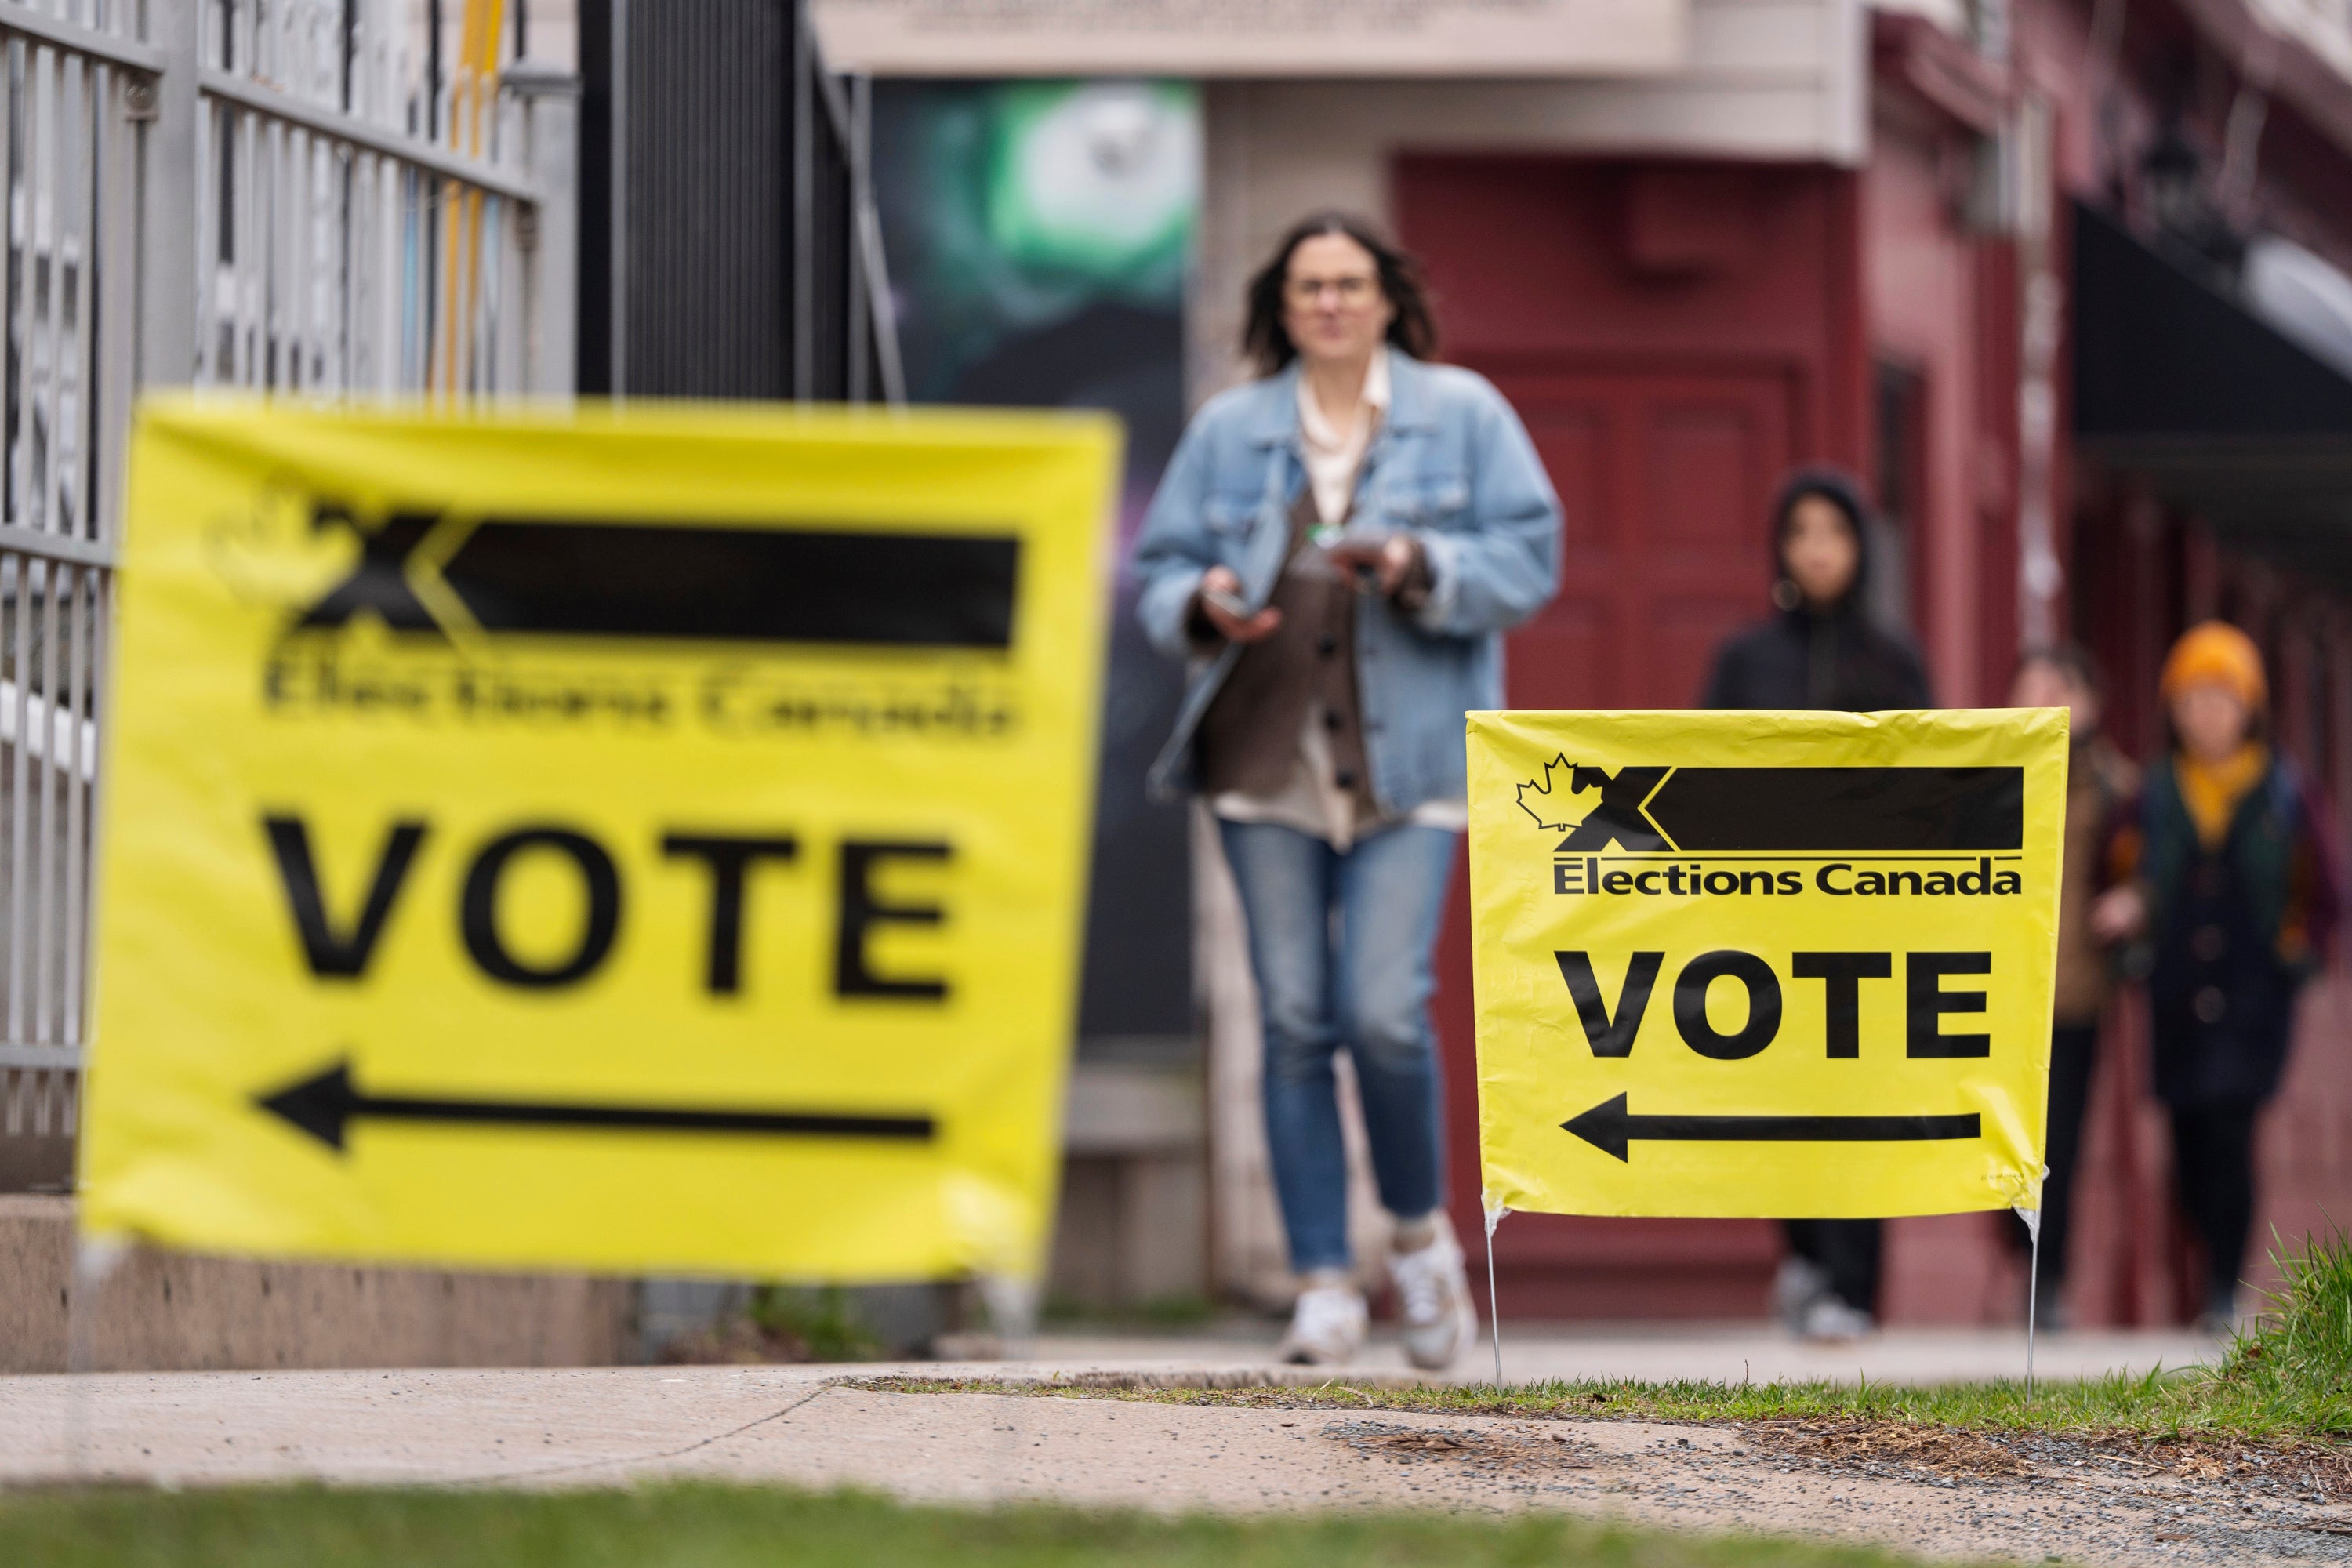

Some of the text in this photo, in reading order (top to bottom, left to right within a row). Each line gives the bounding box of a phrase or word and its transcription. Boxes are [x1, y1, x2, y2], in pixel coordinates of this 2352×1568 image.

[260, 812, 955, 1005] VOTE
[1553, 856, 2023, 895] Elections Canada
[1553, 949, 1992, 1061] VOTE
